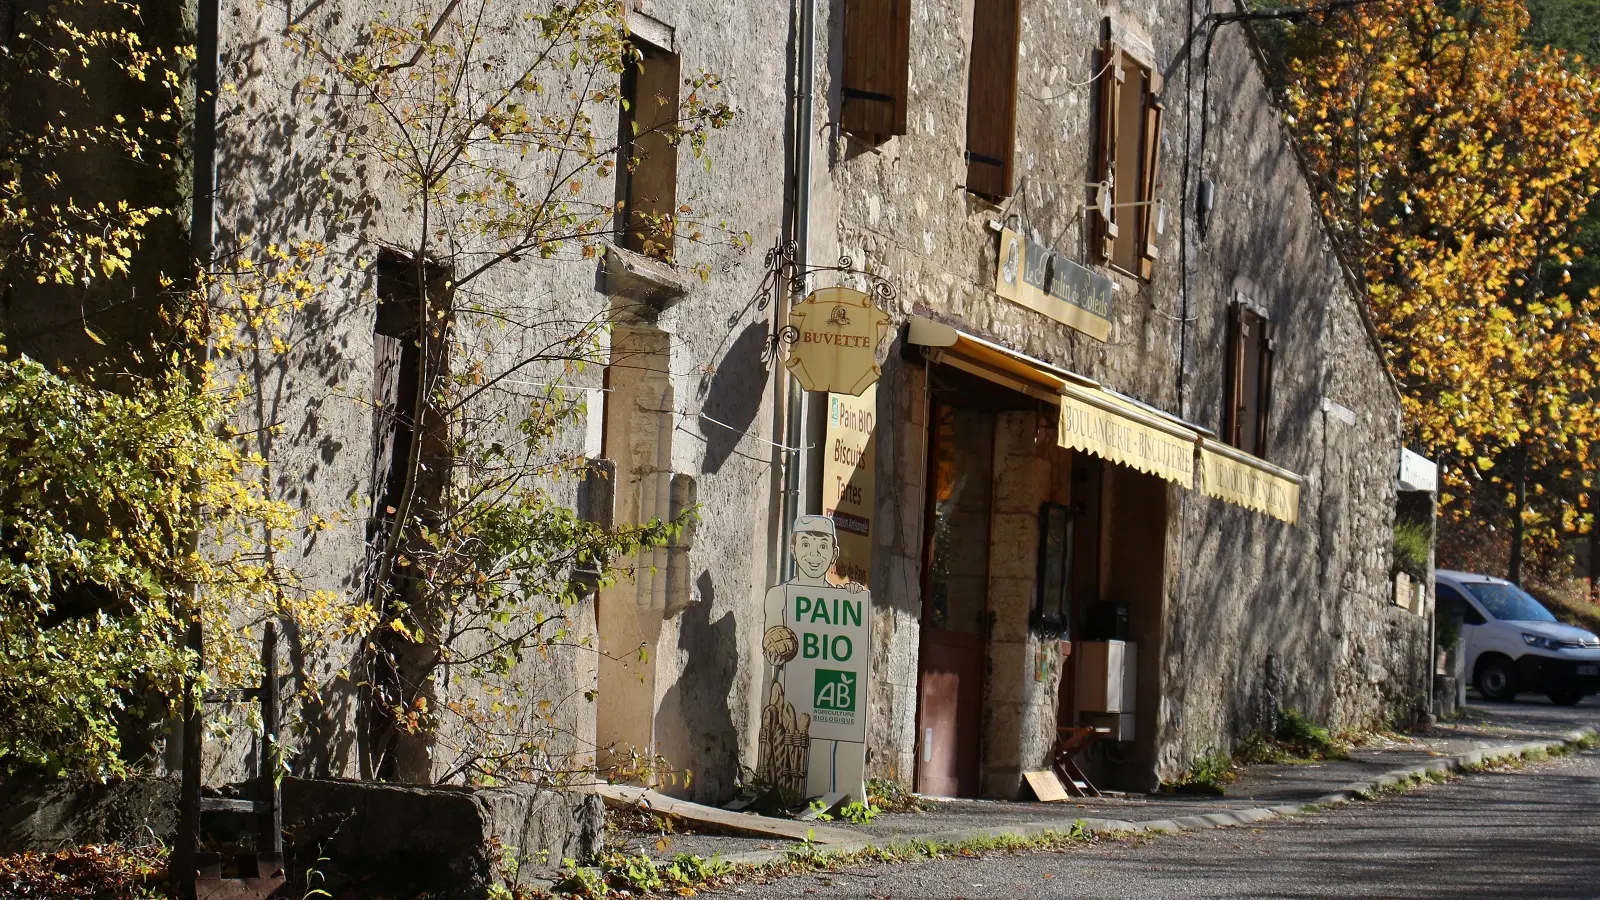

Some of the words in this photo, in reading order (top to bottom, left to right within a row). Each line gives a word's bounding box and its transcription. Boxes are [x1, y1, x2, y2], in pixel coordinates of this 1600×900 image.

[1026, 261, 1034, 282] Le
[1072, 284, 1080, 304] de
[1081, 272, 1108, 317] Soleils
[803, 331, 871, 348] BUVETTE
[840, 402, 857, 431] Pain
[859, 408, 873, 436] BIO
[834, 438, 866, 470] Biscuits
[1065, 404, 1132, 454] BOULANGERIE
[1138, 431, 1191, 473] BISCUITERIE
[837, 475, 862, 506] Tartes
[795, 596, 862, 627] PAIN
[803, 632, 853, 662] BIO
[816, 682, 850, 708] AB
[813, 709, 855, 718] AGRICULTURE
[813, 715, 855, 724] BIOLOGIQUE
